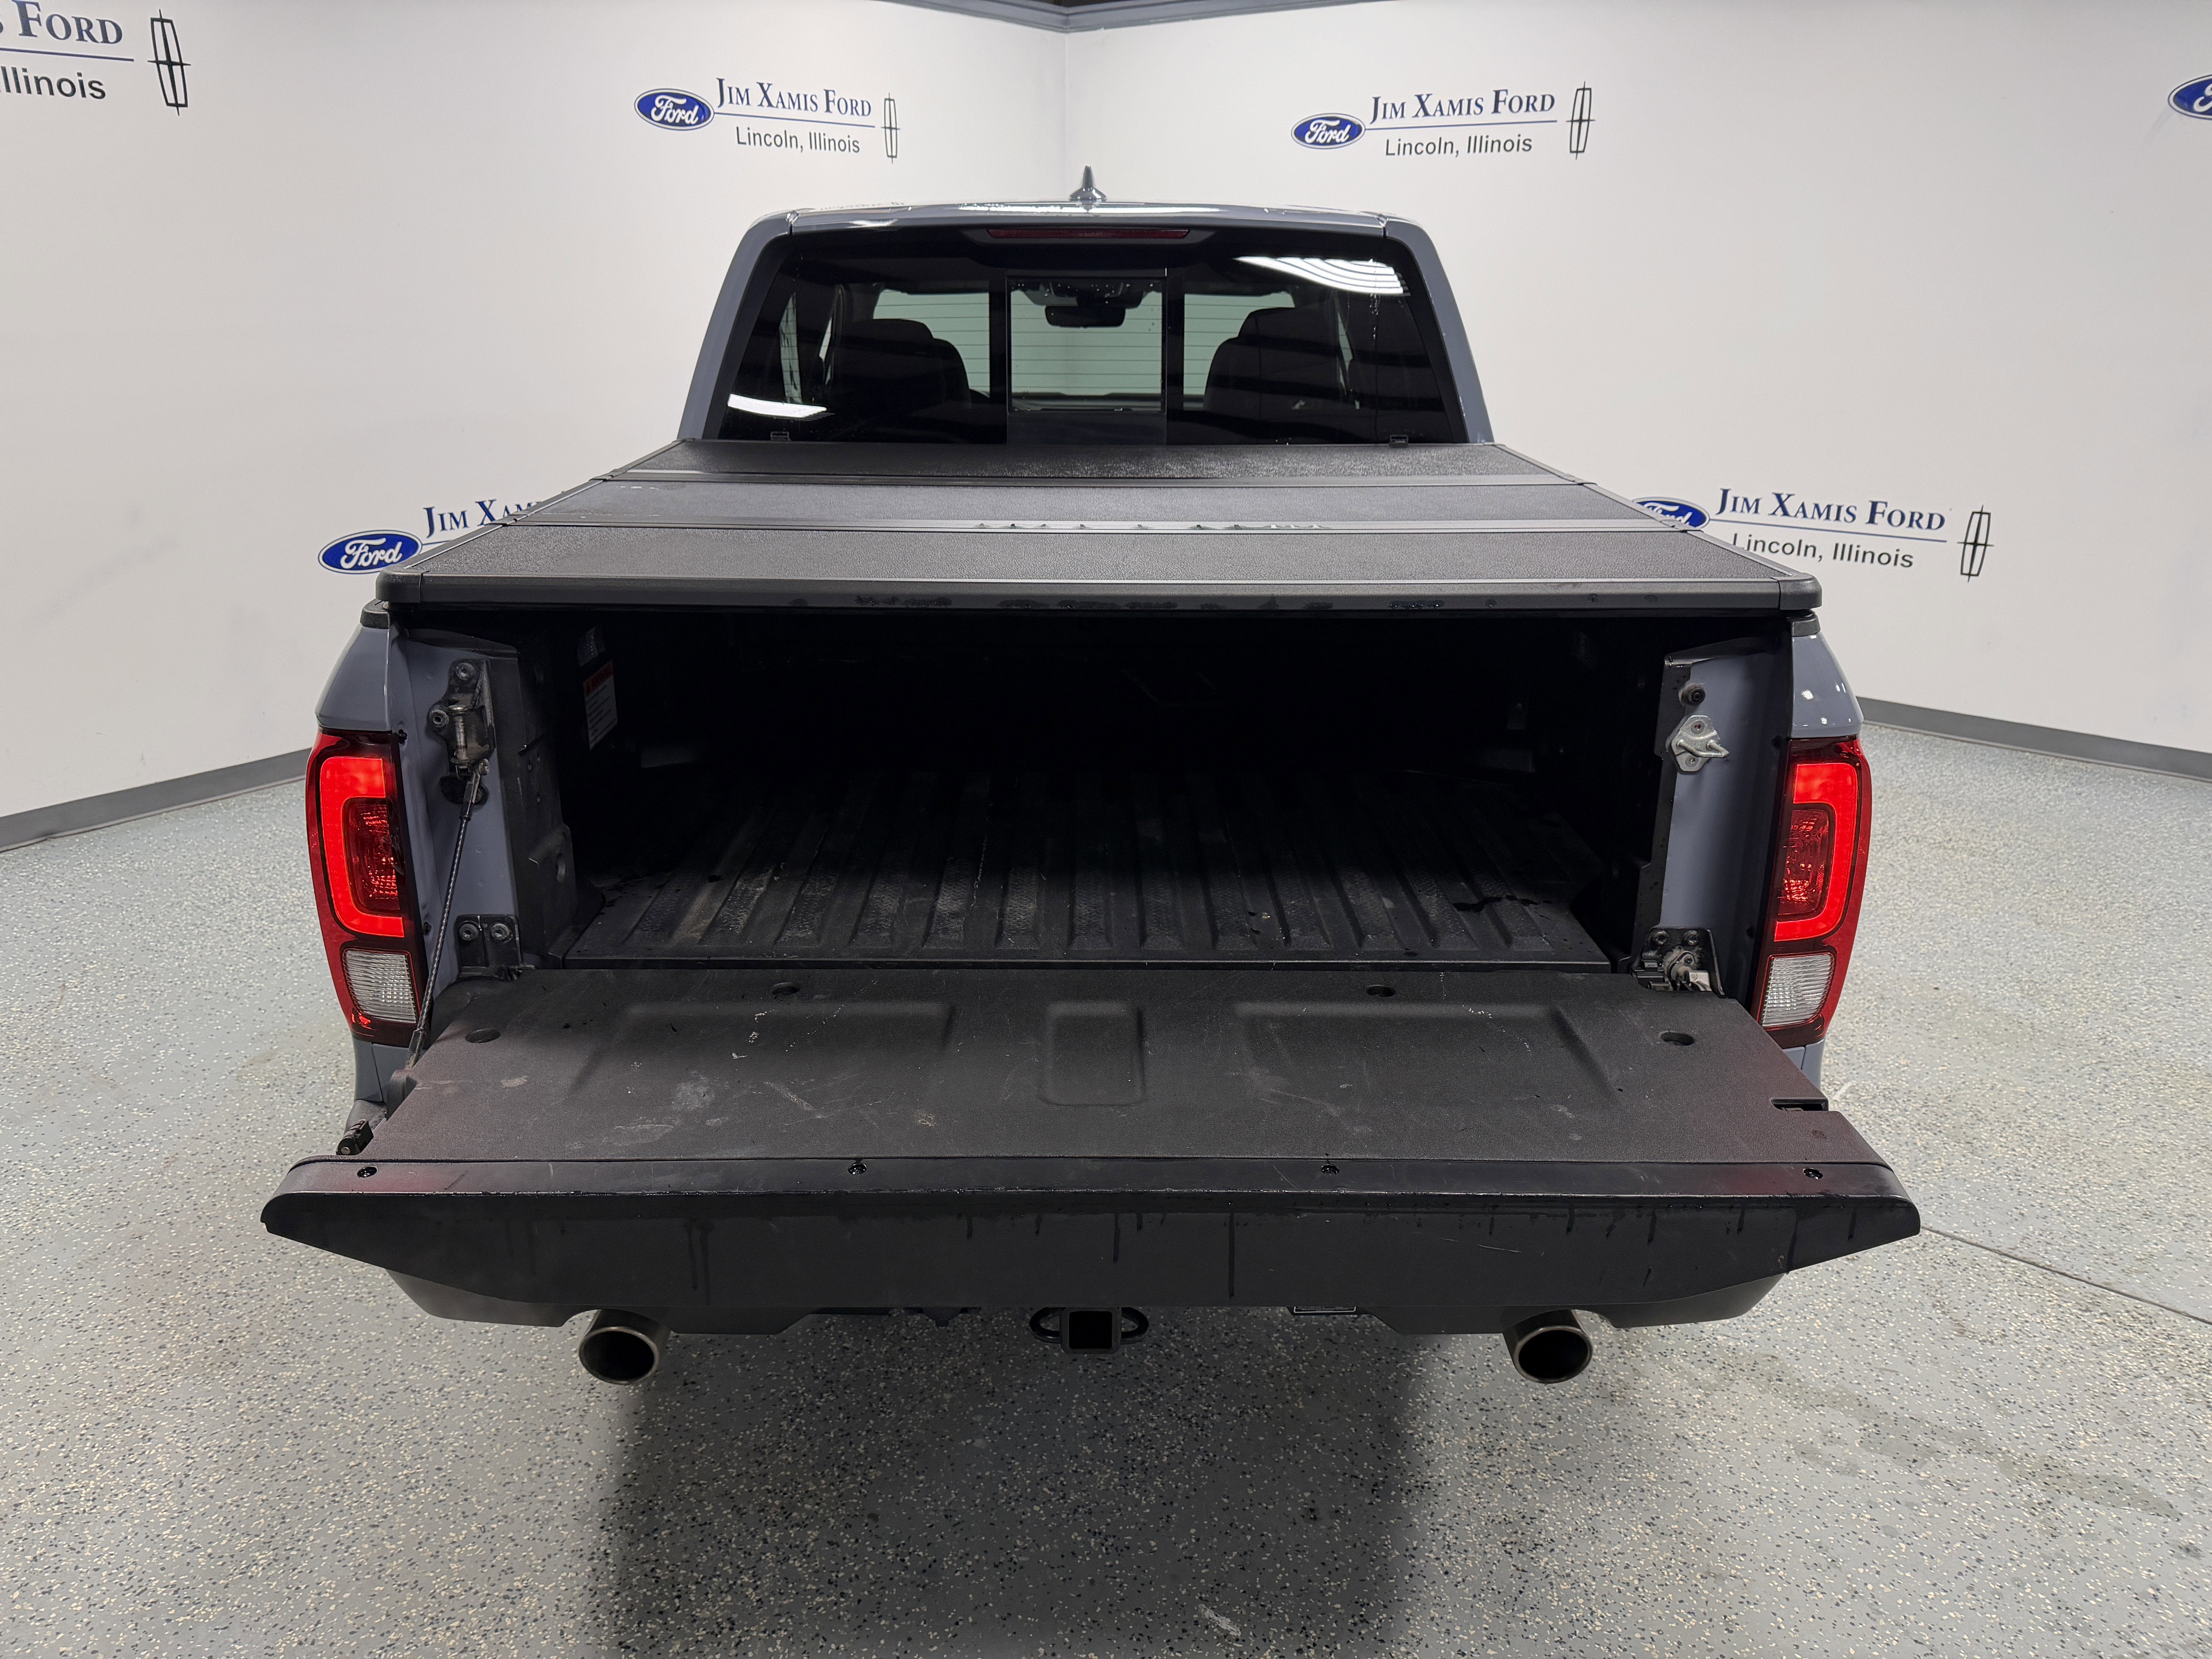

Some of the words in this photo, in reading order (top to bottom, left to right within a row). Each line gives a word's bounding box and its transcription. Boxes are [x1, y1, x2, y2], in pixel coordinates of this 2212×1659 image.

[12, 0, 122, 44] FORD
[0, 66, 106, 100] llinois
[716, 78, 751, 108] JIM
[756, 82, 818, 112] XAMIS
[823, 89, 871, 117] FORD
[651, 95, 699, 124] Ford
[1369, 96, 1405, 124] JIM
[1412, 93, 1484, 118] XAMIS
[1491, 89, 1555, 114] FORD
[737, 126, 803, 153] Lincoln,
[809, 132, 860, 153] Illinois
[1304, 119, 1351, 143] Ford
[1386, 137, 1459, 158] Lincoln,
[1467, 134, 1532, 154] Illinois
[422, 507, 470, 538] JIM
[1716, 488, 1761, 515] JIM
[1768, 492, 1857, 523] XAMIS
[1865, 500, 1946, 531] FORD
[340, 538, 402, 569] Ford
[1832, 543, 1913, 568] Illinois
